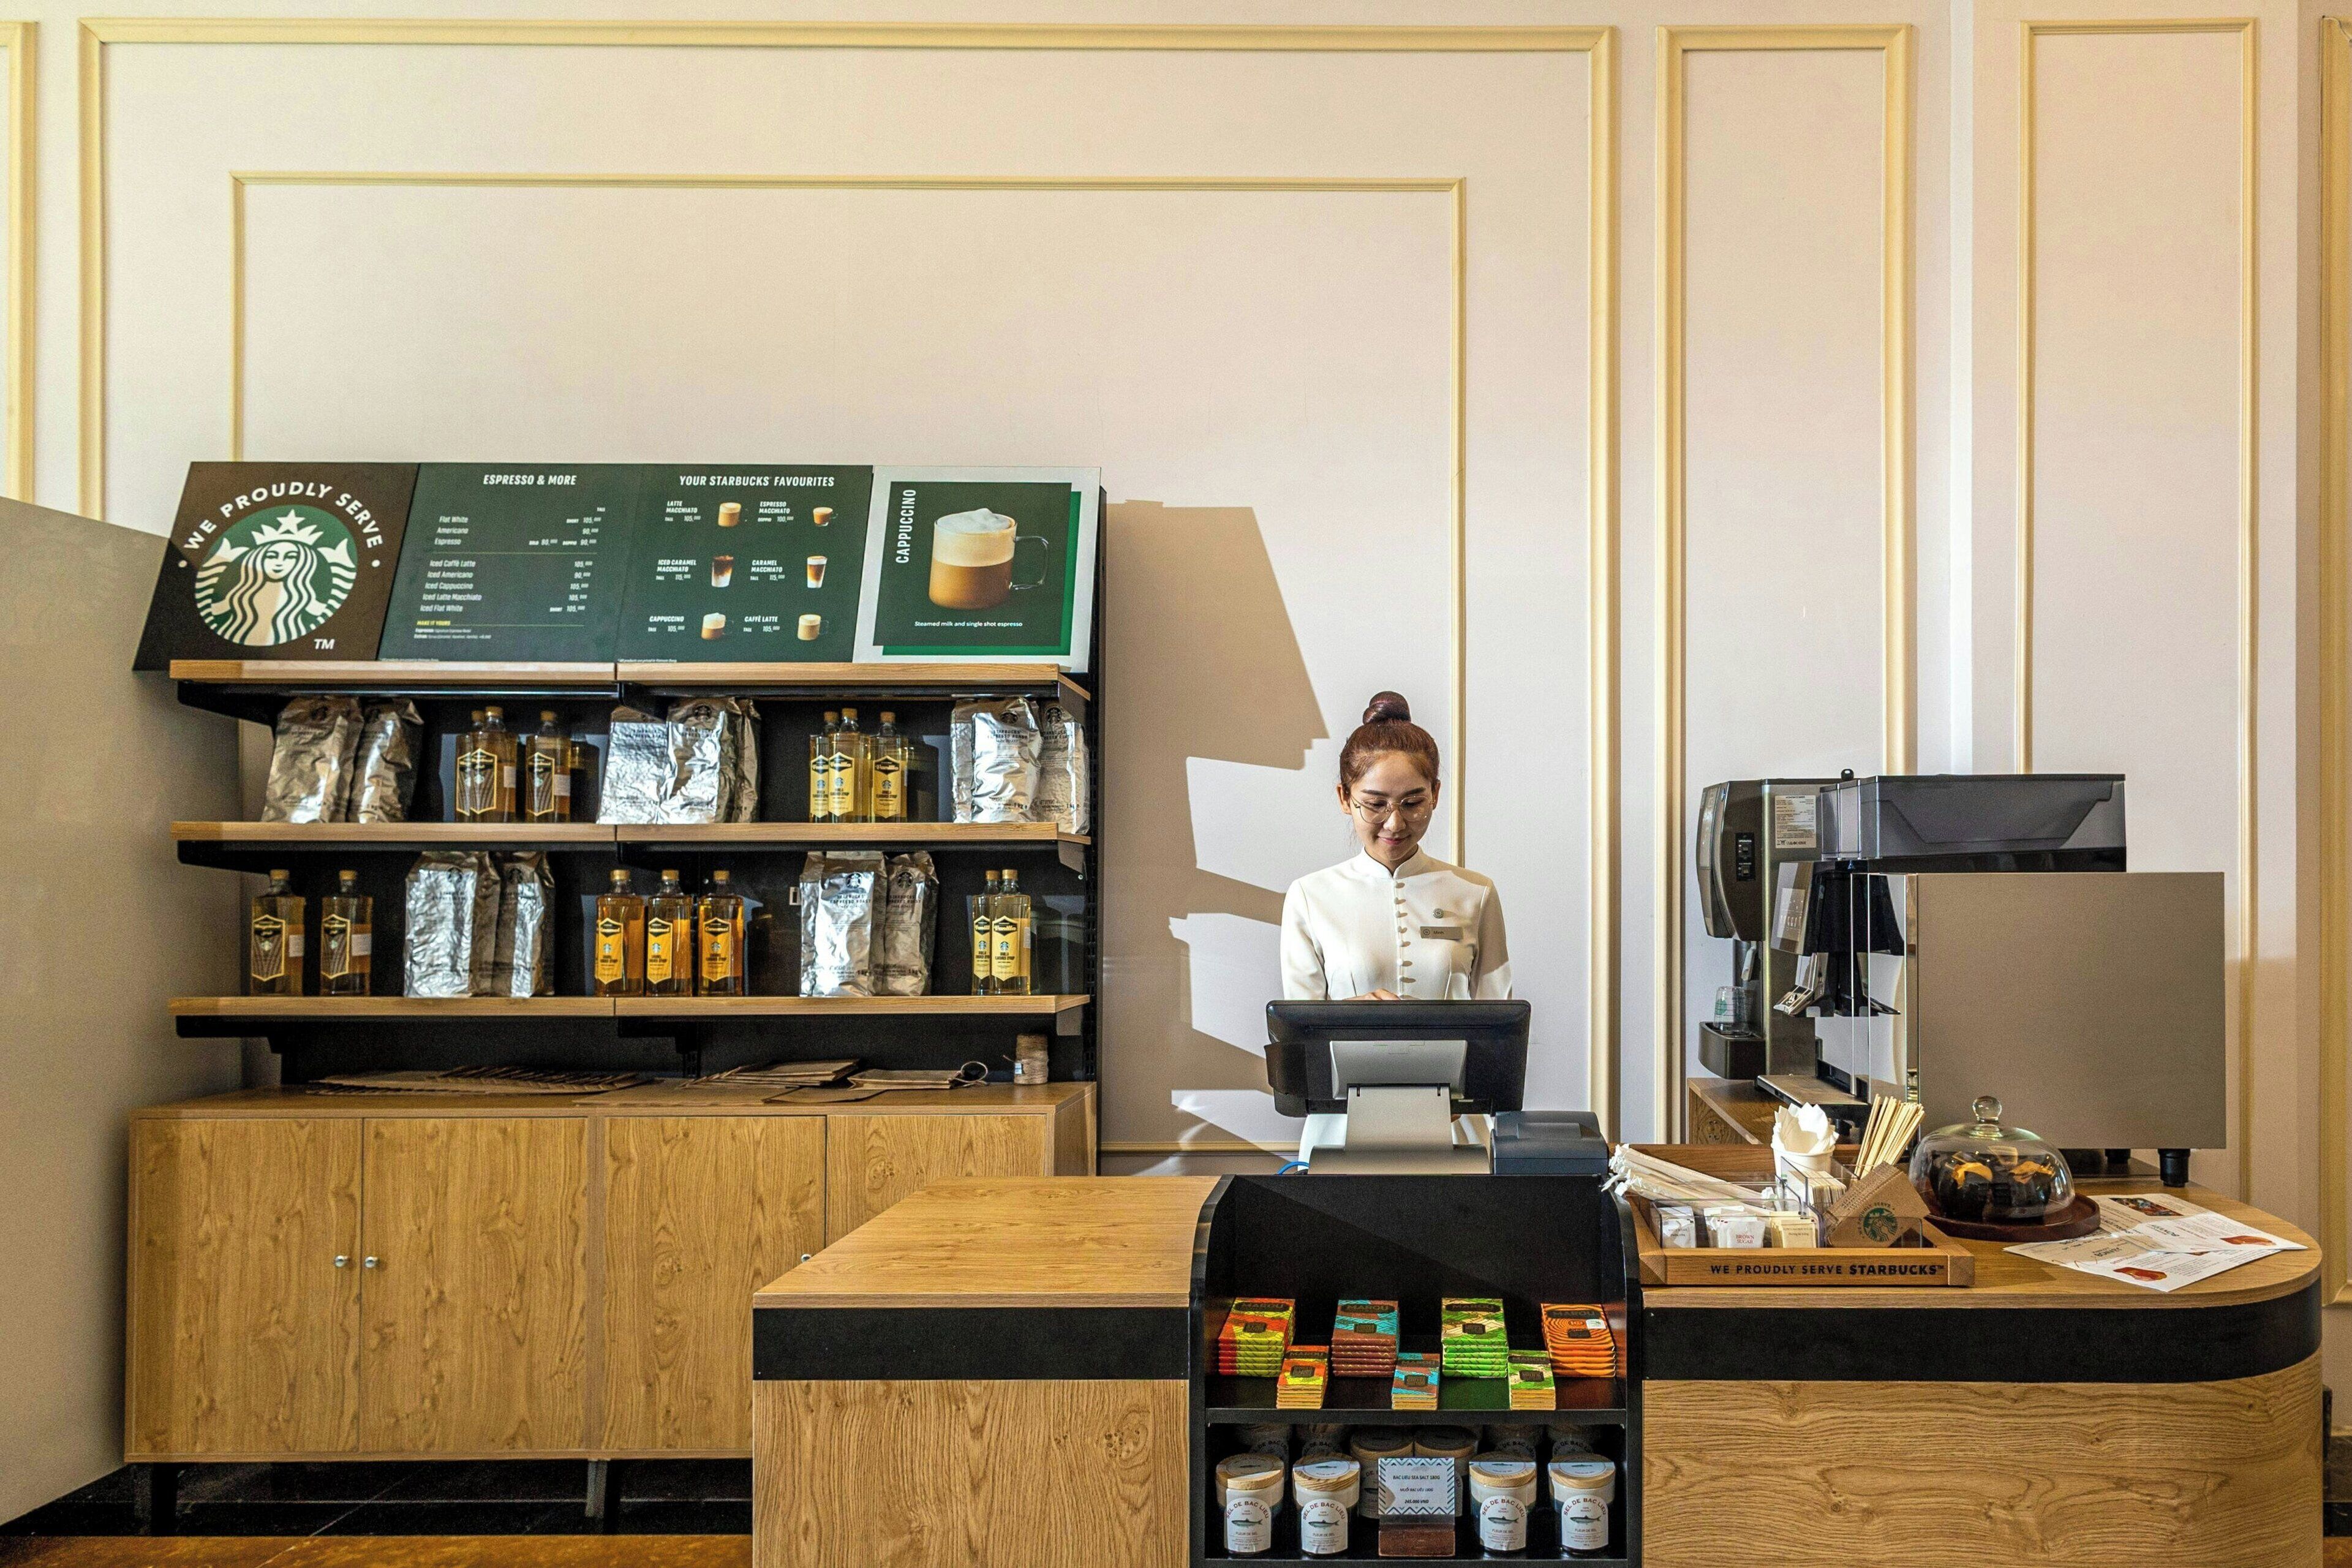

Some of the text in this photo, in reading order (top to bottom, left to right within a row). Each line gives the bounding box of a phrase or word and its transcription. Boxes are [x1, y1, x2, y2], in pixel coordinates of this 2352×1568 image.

[483, 474, 577, 485] ESPRESSO & MORE
[679, 475, 835, 487] YOUR STARBUCKS FAVOURITES
[184, 482, 383, 550] WE PROUDLY SERVE
[895, 489, 916, 564] CAPPUCCINO
[314, 639, 335, 649] TM
[1710, 1265, 1730, 1275] WE
[1736, 1265, 1796, 1275] PROUDLY
[1802, 1265, 1842, 1275] SERVE
[1234, 1501, 1243, 1510] DE
[1259, 1505, 1269, 1519] LIEU
[1302, 1509, 1311, 1520] SEL
[1335, 1506, 1346, 1520] LIEU
[1482, 1505, 1490, 1515] SEL
[1515, 1502, 1525, 1518] LIEU
[1564, 1504, 1572, 1516] SEL
[1597, 1501, 1607, 1515] LIEU
